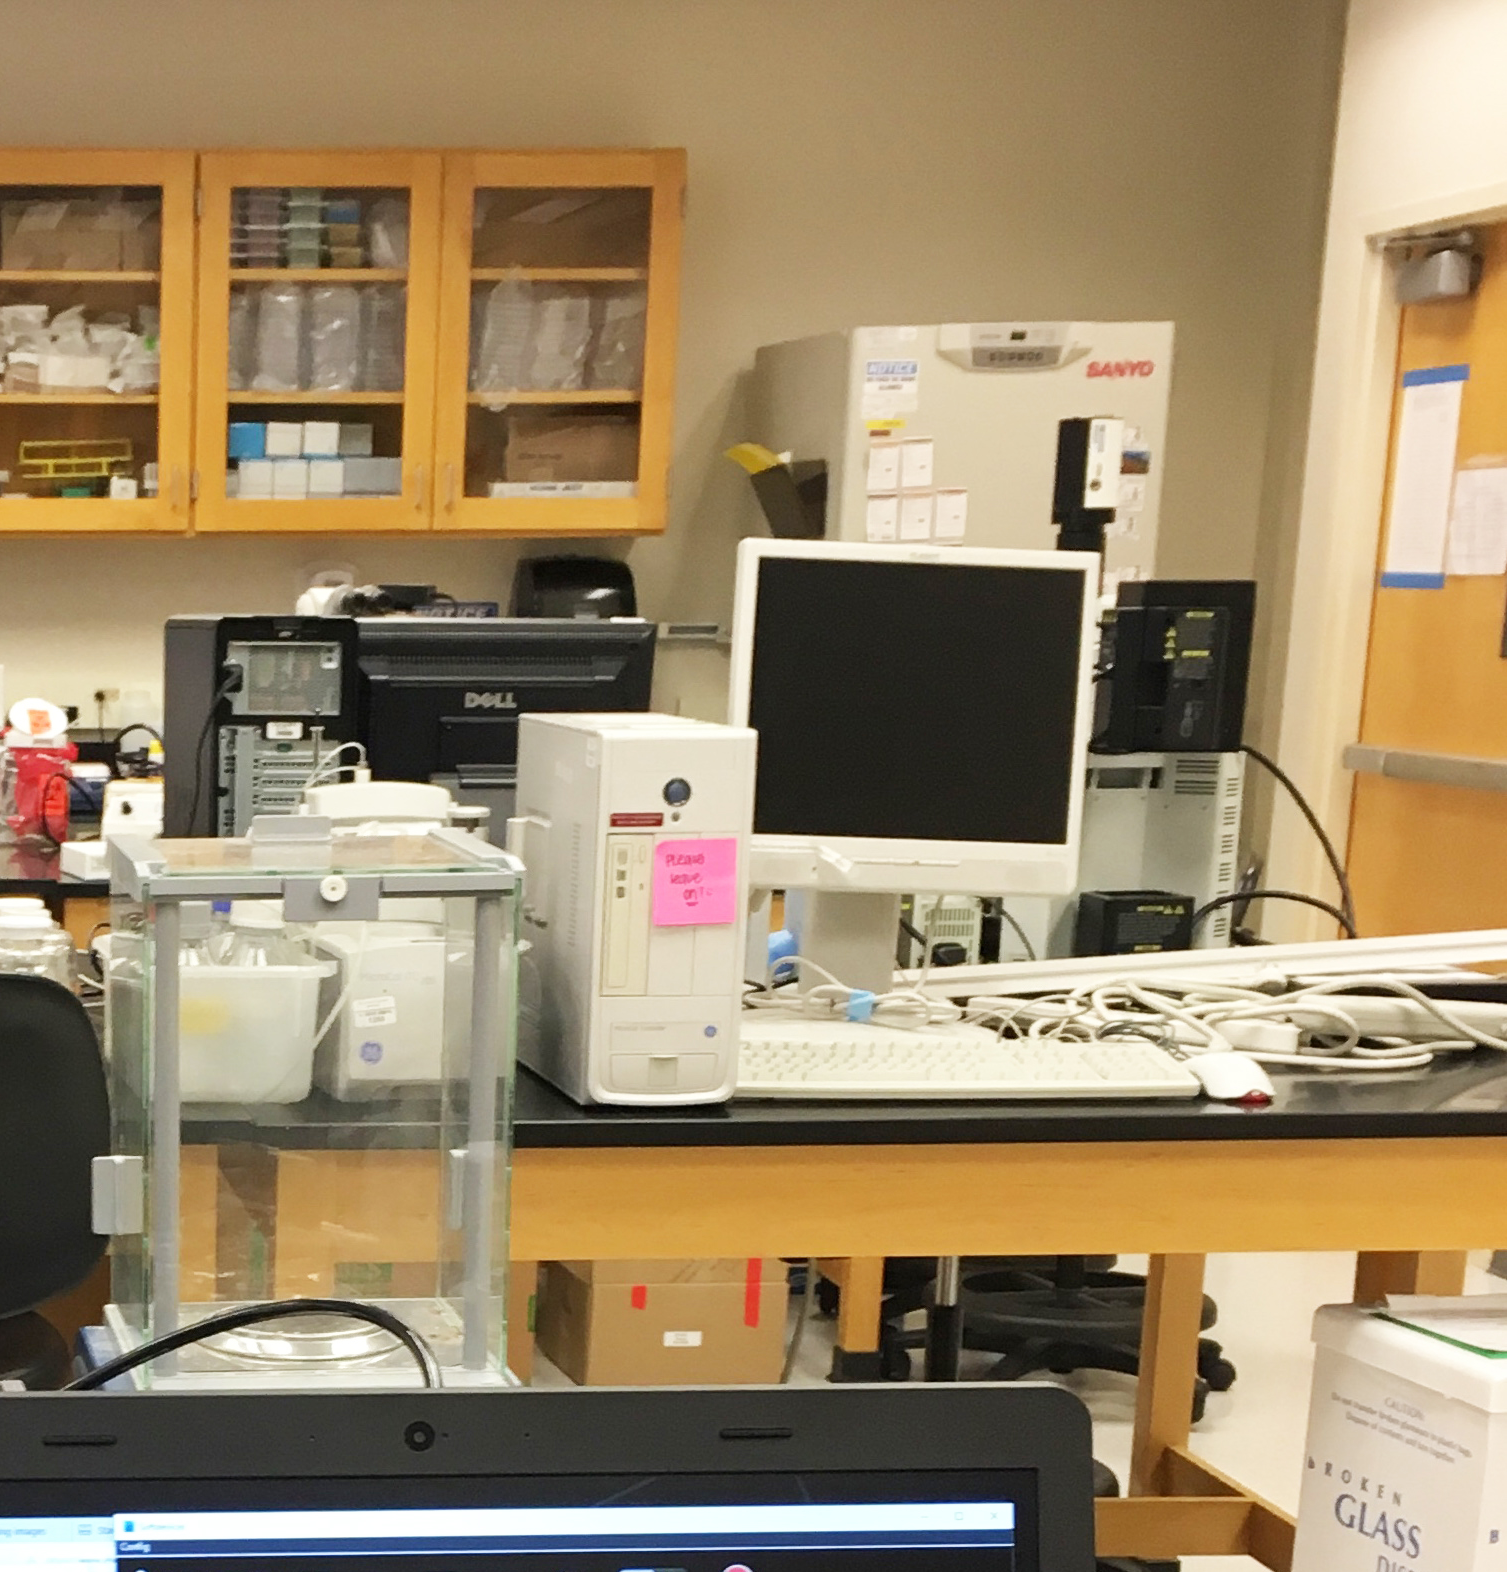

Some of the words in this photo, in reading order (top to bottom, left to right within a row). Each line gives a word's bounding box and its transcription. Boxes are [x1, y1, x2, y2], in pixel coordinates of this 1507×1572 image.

[1085, 360, 1155, 379] SANYO
[463, 692, 518, 709] DELL
[1334, 1493, 1422, 1559] GLASS
